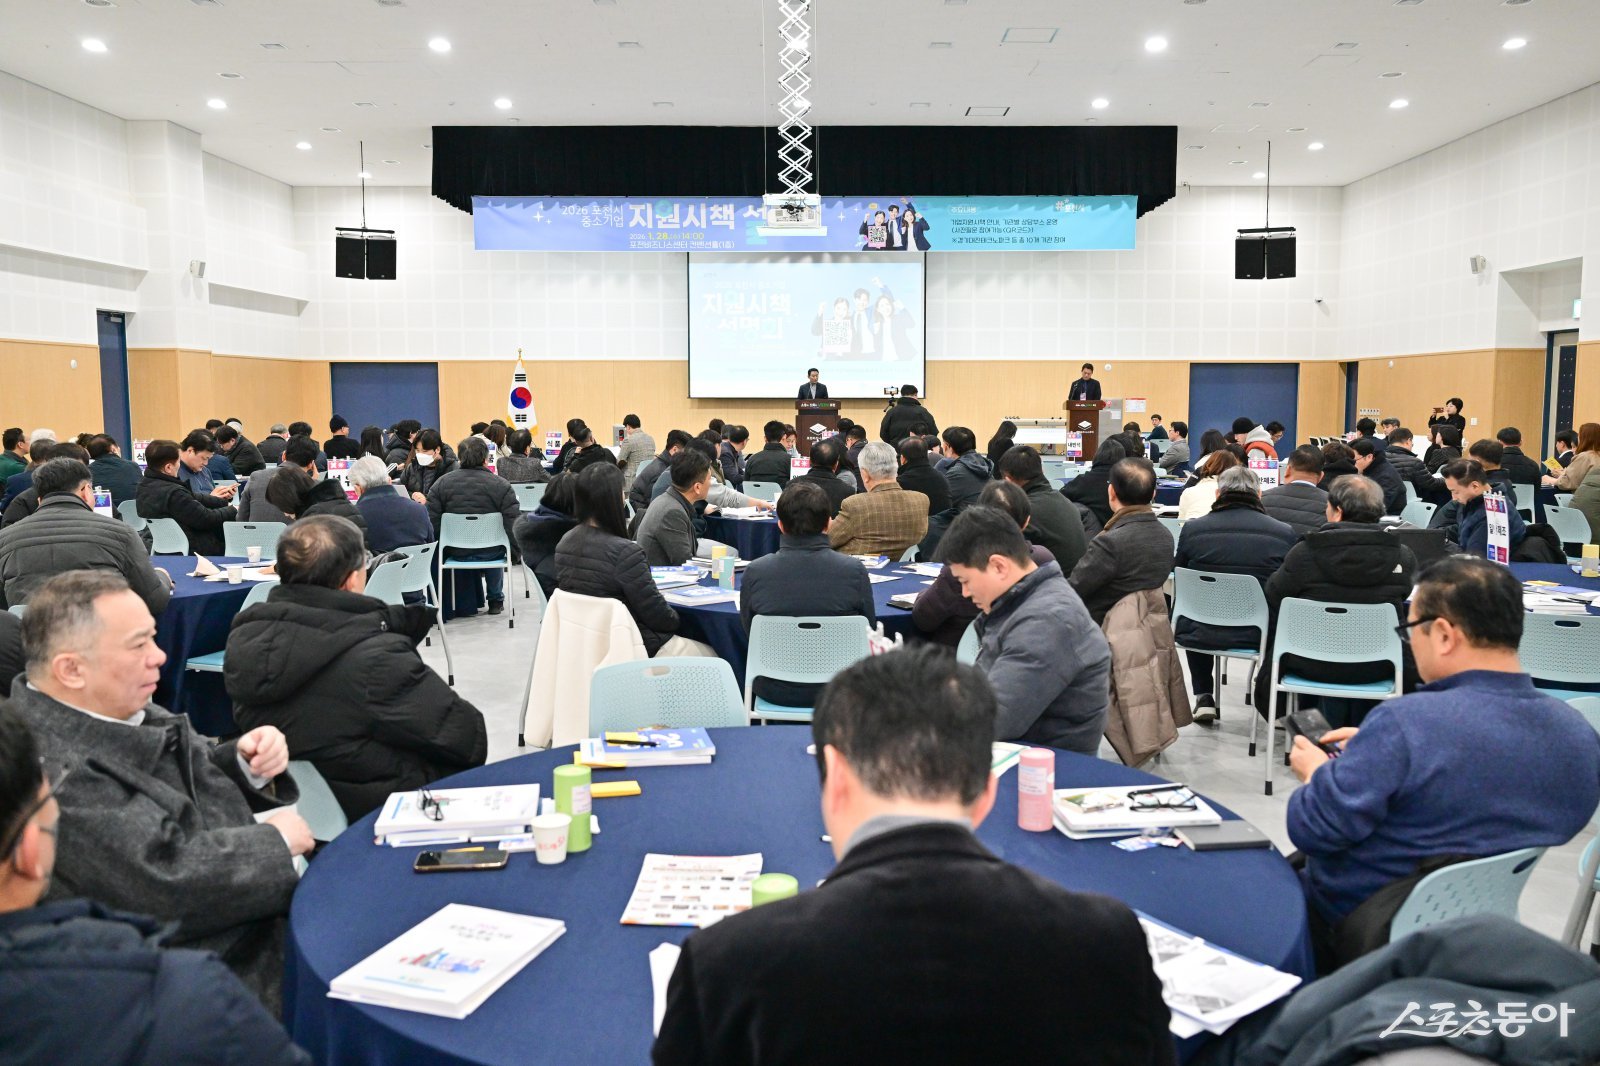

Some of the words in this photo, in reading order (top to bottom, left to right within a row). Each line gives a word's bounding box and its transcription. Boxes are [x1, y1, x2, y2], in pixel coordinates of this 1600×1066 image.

[562, 205, 588, 215] 2026
[592, 205, 623, 217] 포천시
[629, 202, 735, 229] 지원시책
[581, 215, 623, 228] 중소기업
[702, 292, 791, 315] 지원시책
